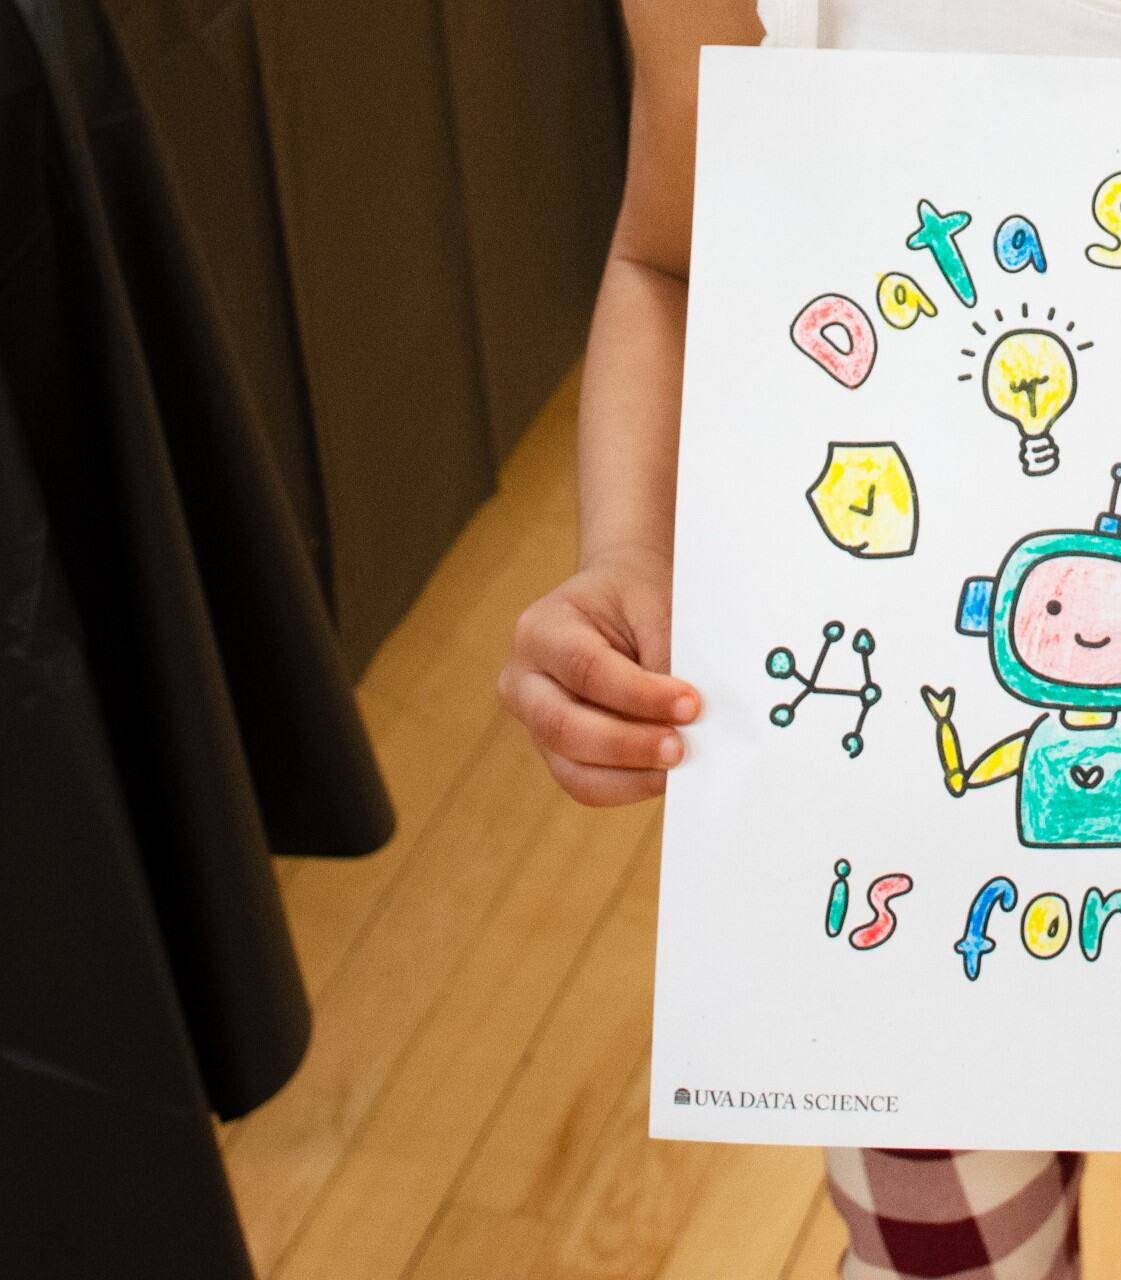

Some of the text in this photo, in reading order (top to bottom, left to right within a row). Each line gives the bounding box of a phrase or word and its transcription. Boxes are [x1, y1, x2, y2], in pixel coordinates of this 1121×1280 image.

[789, 198, 1048, 390] Data
[824, 858, 914, 951] is
[694, 1089, 899, 1113] UVA DATA SCIENCE
